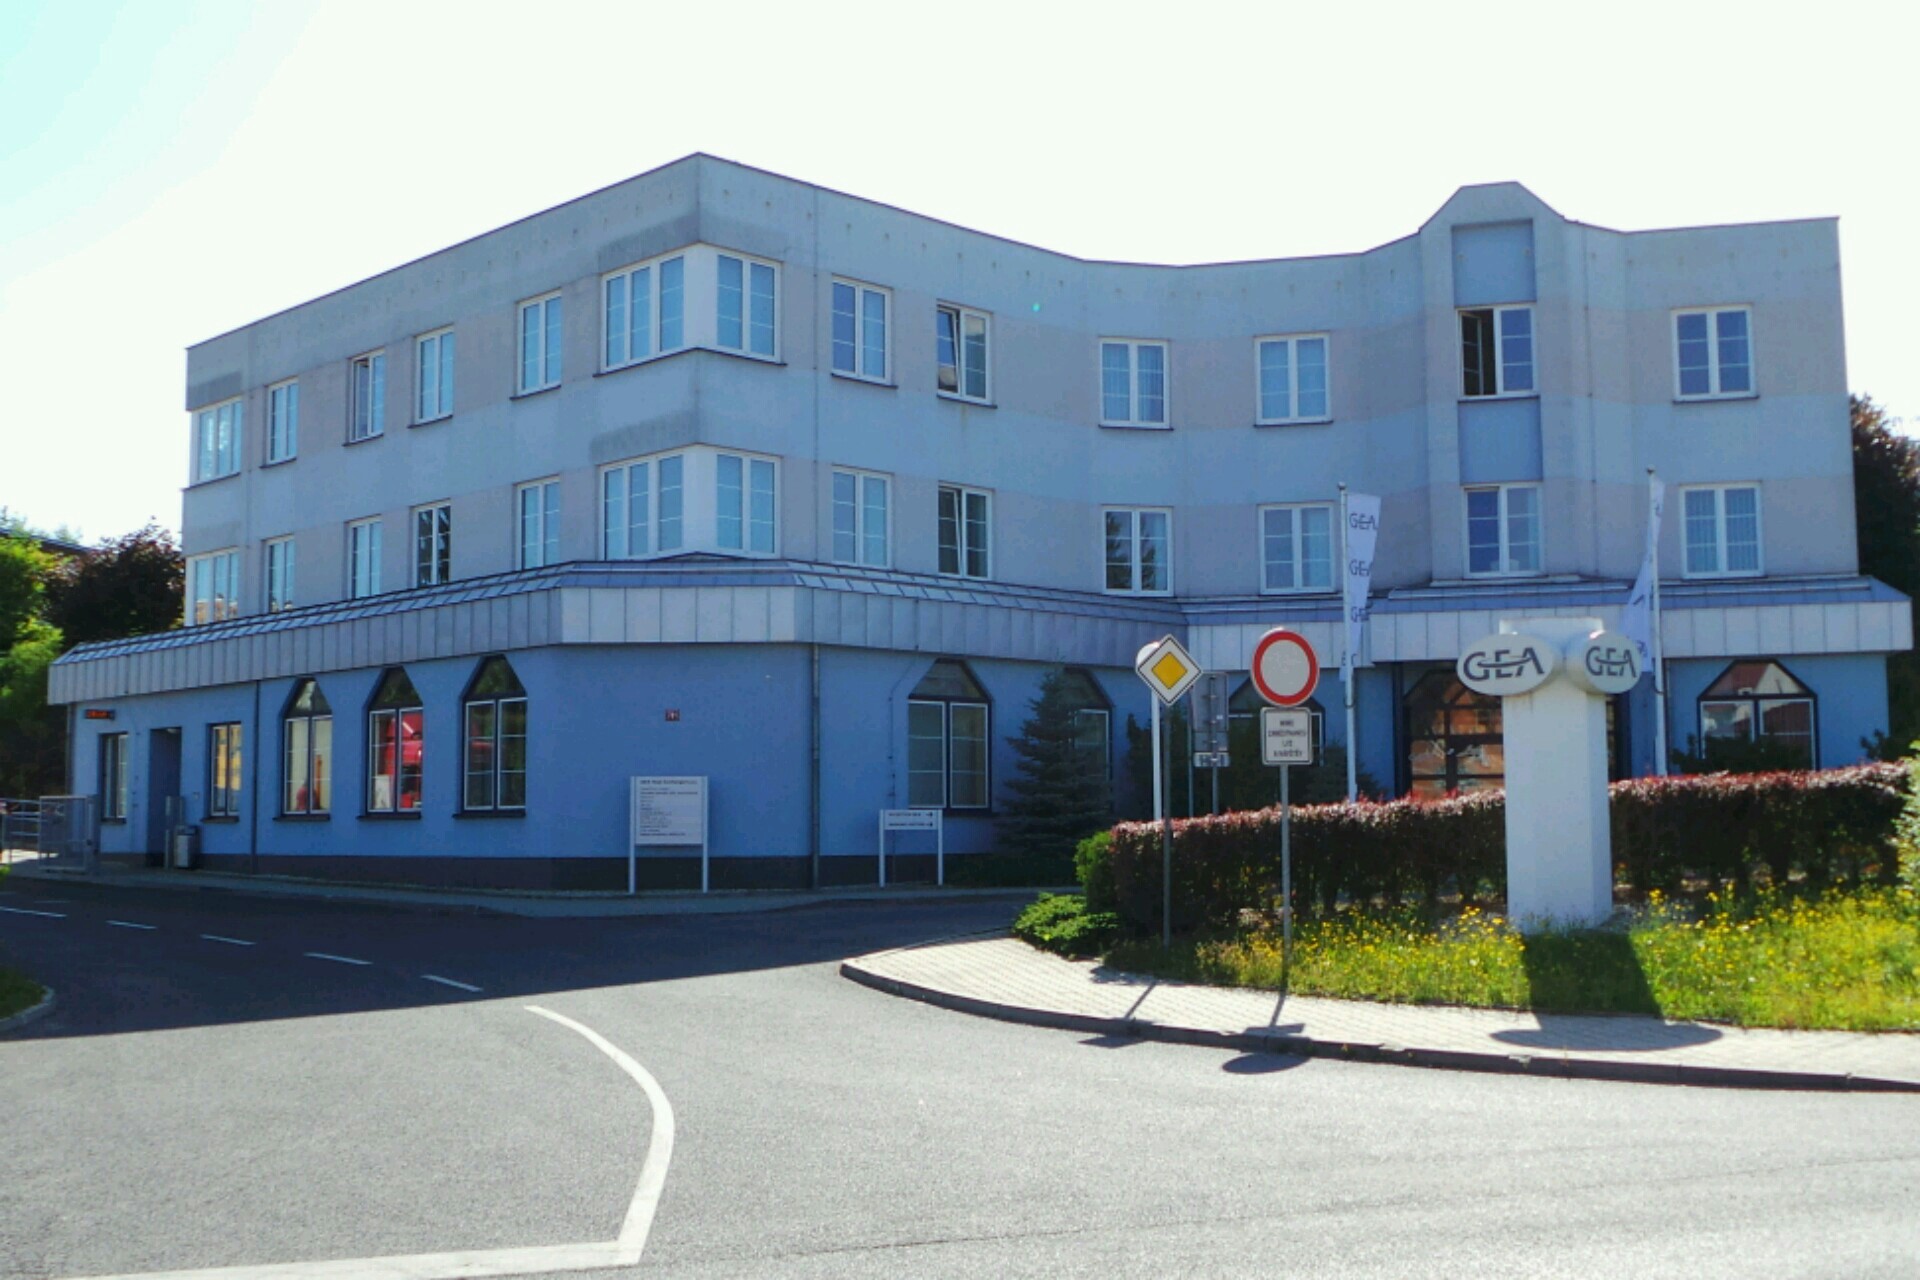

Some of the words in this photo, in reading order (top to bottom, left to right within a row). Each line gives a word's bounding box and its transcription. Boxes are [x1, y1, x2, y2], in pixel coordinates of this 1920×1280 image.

[1349, 512, 1378, 530] GEA
[1463, 647, 1545, 682] GEA
[1586, 646, 1637, 678] GEA
